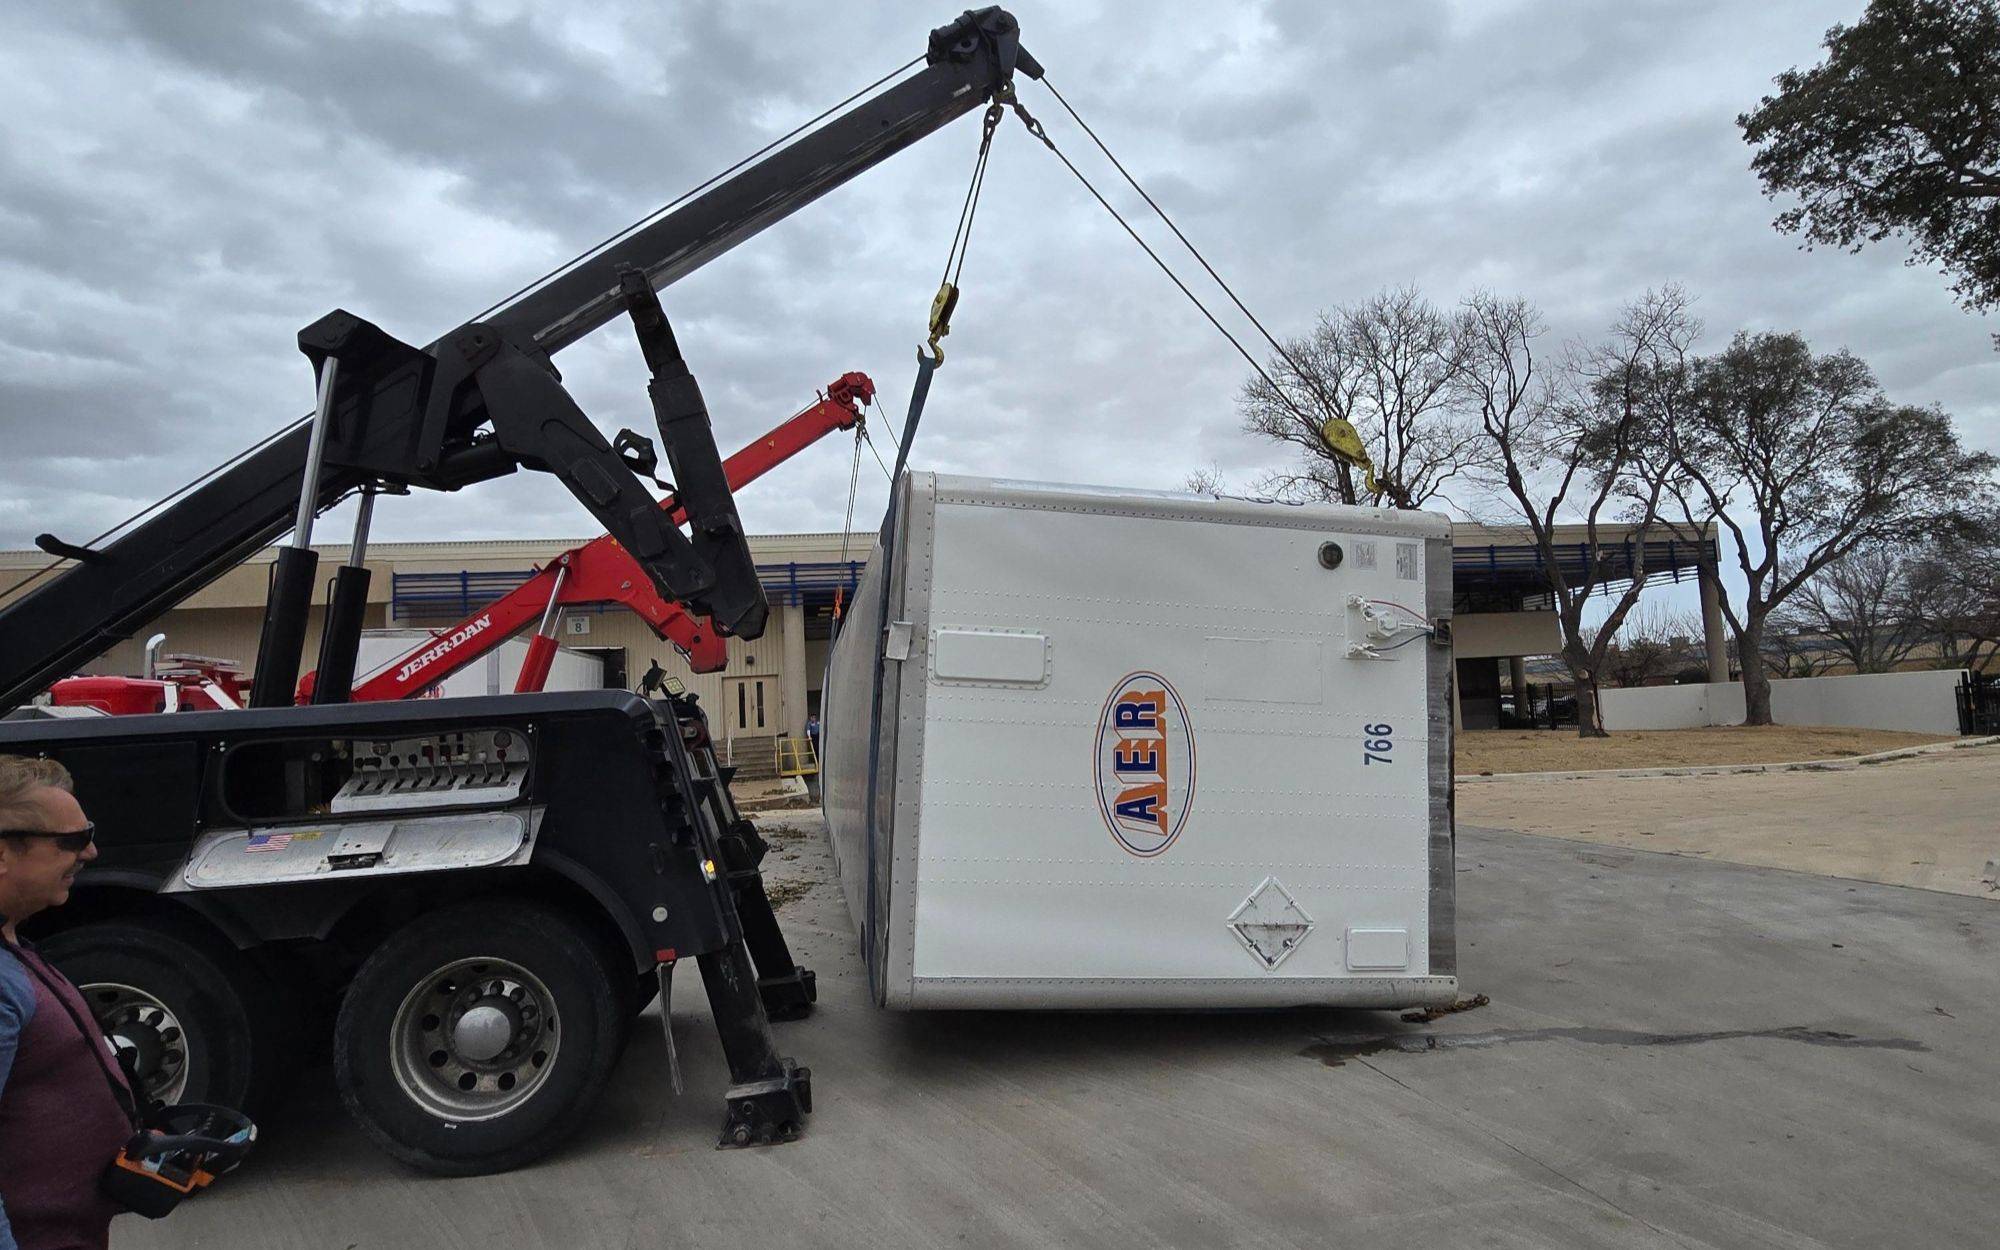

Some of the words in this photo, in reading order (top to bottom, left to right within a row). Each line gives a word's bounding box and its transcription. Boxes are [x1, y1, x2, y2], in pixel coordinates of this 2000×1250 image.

[575, 622, 582, 633] 8
[1113, 690, 1168, 836] AER
[1364, 723, 1393, 766] 766
